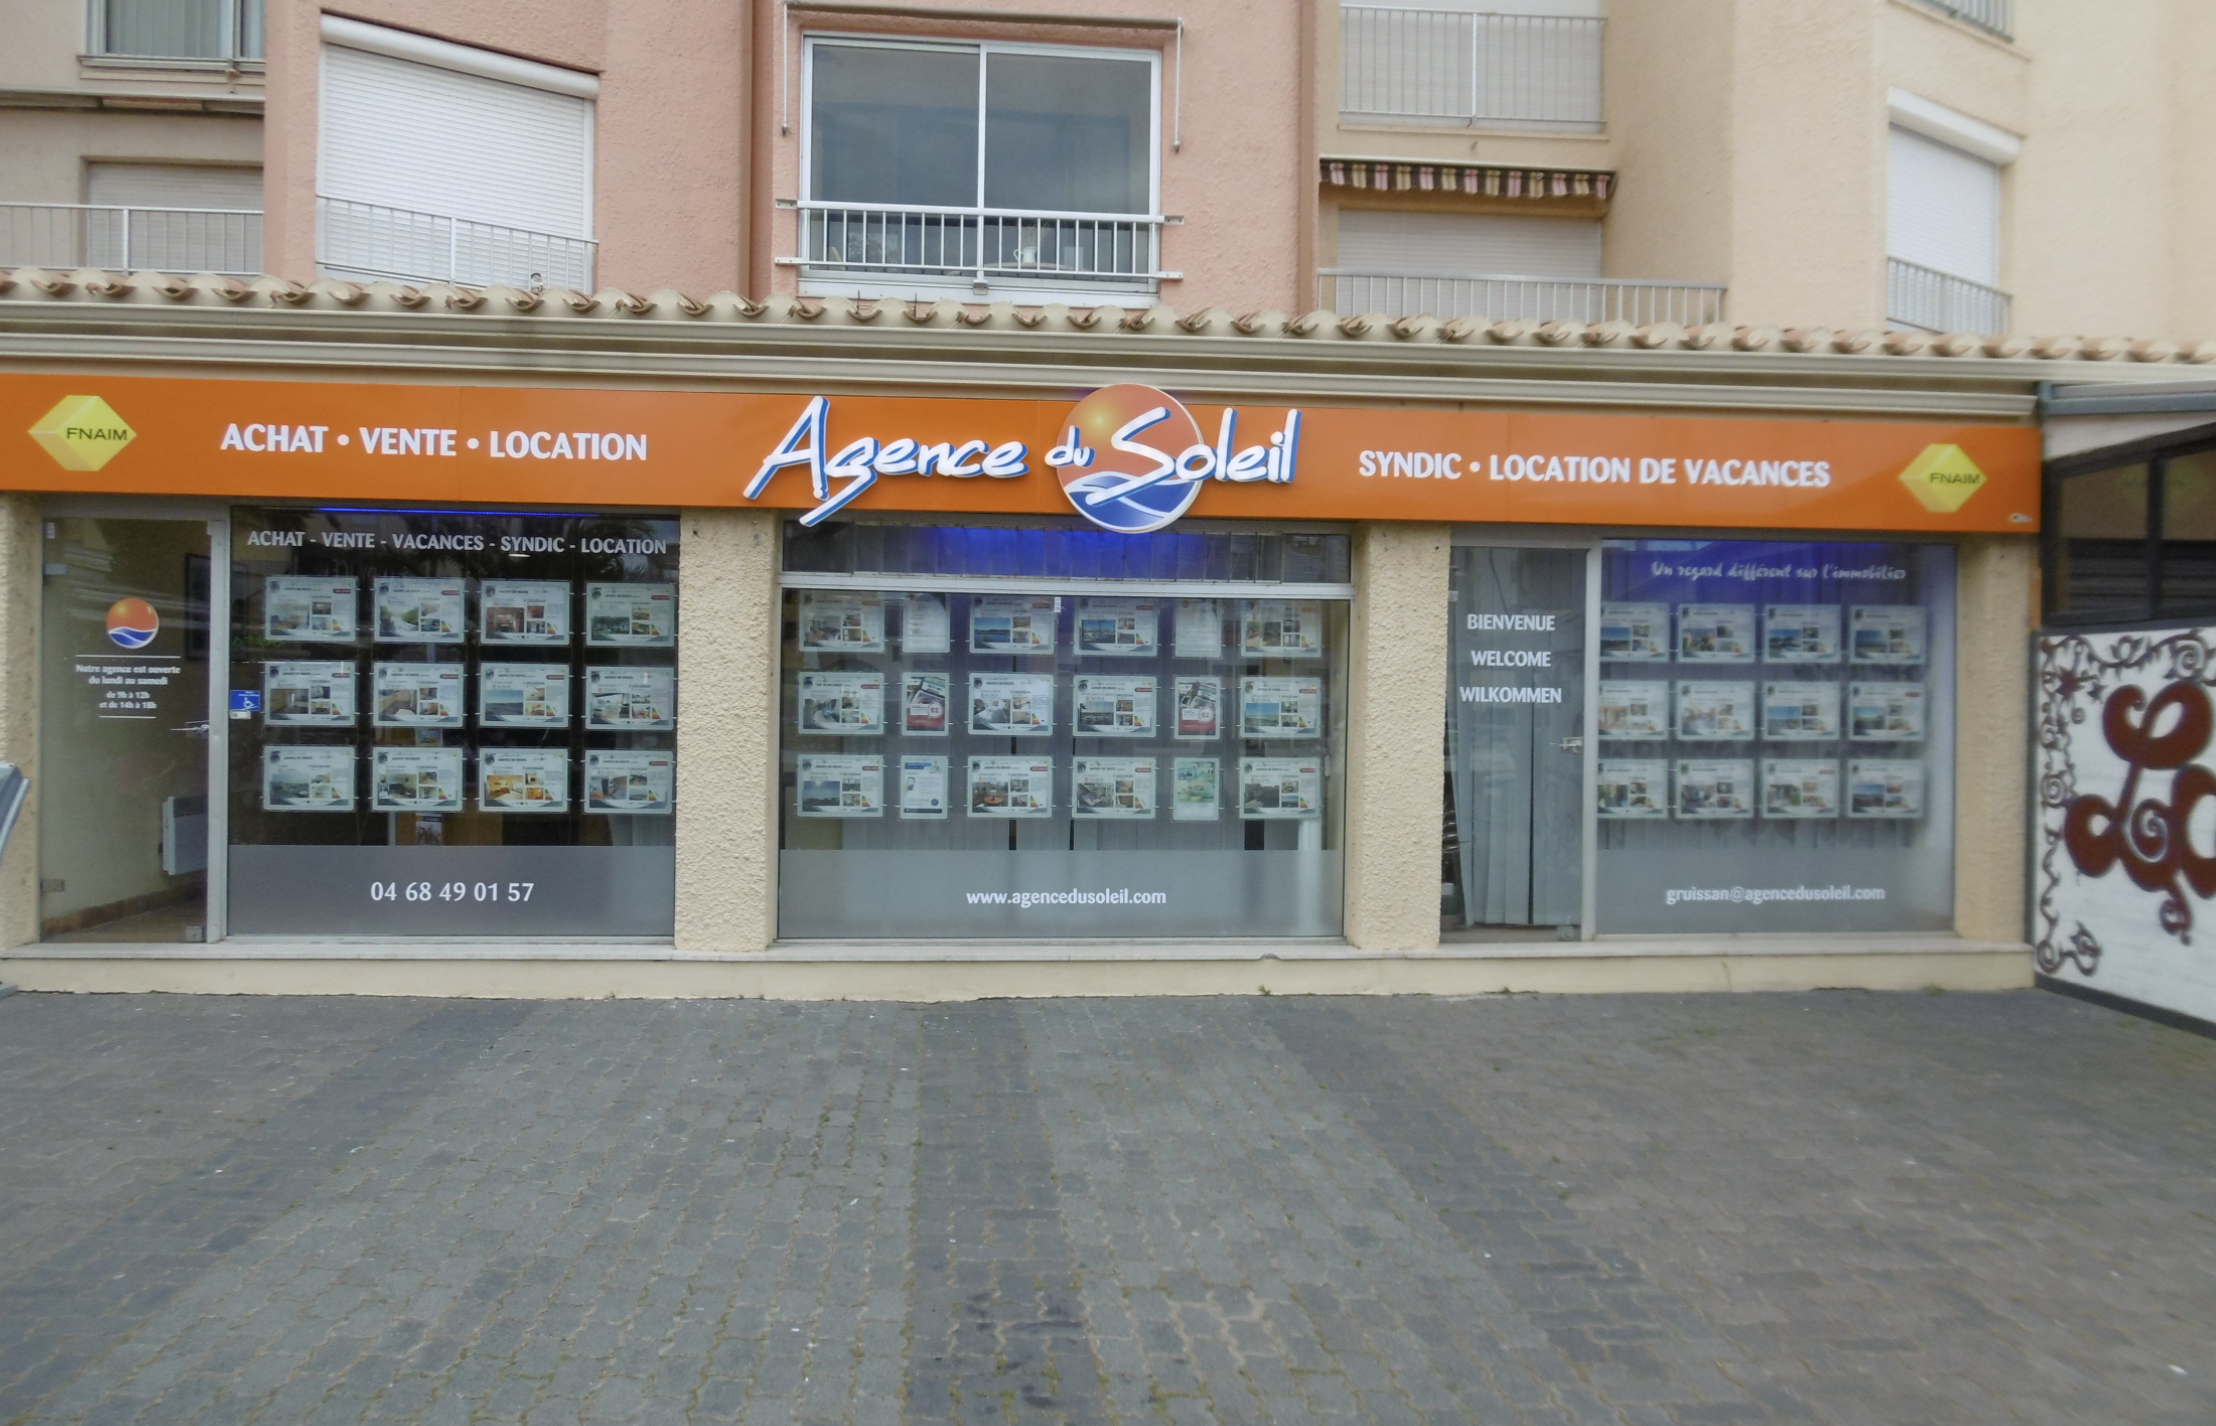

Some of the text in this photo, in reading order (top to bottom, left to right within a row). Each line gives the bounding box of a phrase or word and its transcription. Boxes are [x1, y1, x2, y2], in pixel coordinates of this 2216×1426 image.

[66, 426, 129, 443] FNAIM
[220, 423, 648, 461] ACHAT VENTE LOCATION
[742, 395, 1303, 528] Agence du Soleil
[1358, 449, 1832, 489] SYNDIC LOCATION DE VACANCES
[1929, 472, 1981, 484] FNAIM
[247, 531, 667, 554] ACHAT VENTE VACANCES SYNDIC LOCATION
[1651, 561, 1907, 581] Un regard différent sur l'immobilier
[1467, 613, 1556, 632] BIENVENUE
[1471, 650, 1552, 667] WELCOME
[75, 664, 100, 673] Notre
[102, 666, 132, 675] agence
[148, 665, 181, 674] ouverte
[89, 676, 100, 684] du
[102, 676, 123, 684] lundi
[137, 676, 168, 685] samedi
[1460, 686, 1562, 704] WILKOMMEN
[370, 881, 535, 902] 04 68 49 01 57
[966, 888, 1167, 909] www.agencedusoleil.com
[1666, 885, 1886, 905] gruissan@agencedusoleil.com
